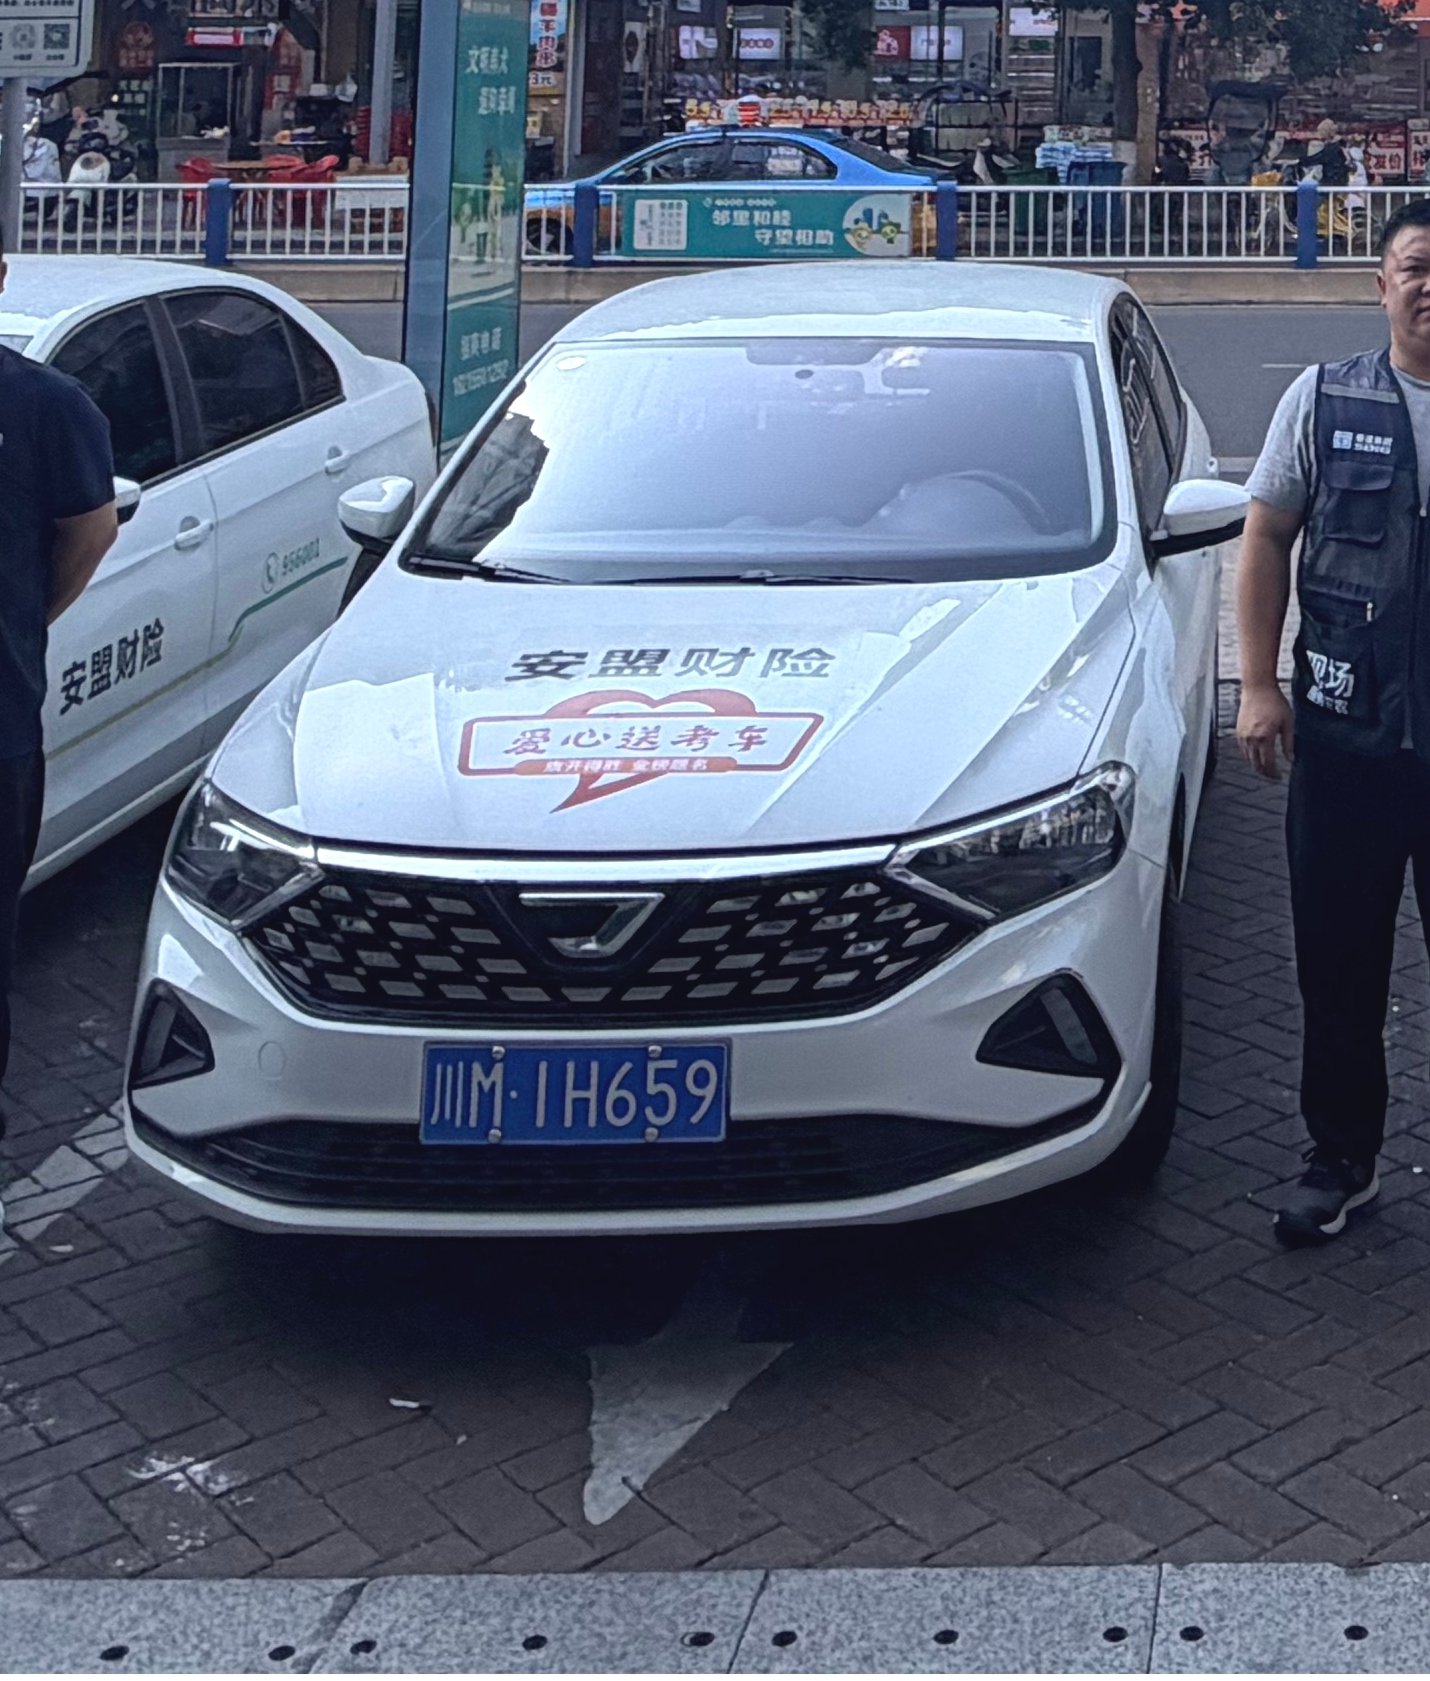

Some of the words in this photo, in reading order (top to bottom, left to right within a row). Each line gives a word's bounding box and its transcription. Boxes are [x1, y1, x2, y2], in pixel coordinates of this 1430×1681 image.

[754, 229, 834, 246] 守望相助
[59, 617, 165, 716] 安盟财险
[504, 647, 837, 682] 安盟财险
[502, 724, 769, 757] 爱心送考车
[632, 758, 708, 771] 金榜题名
